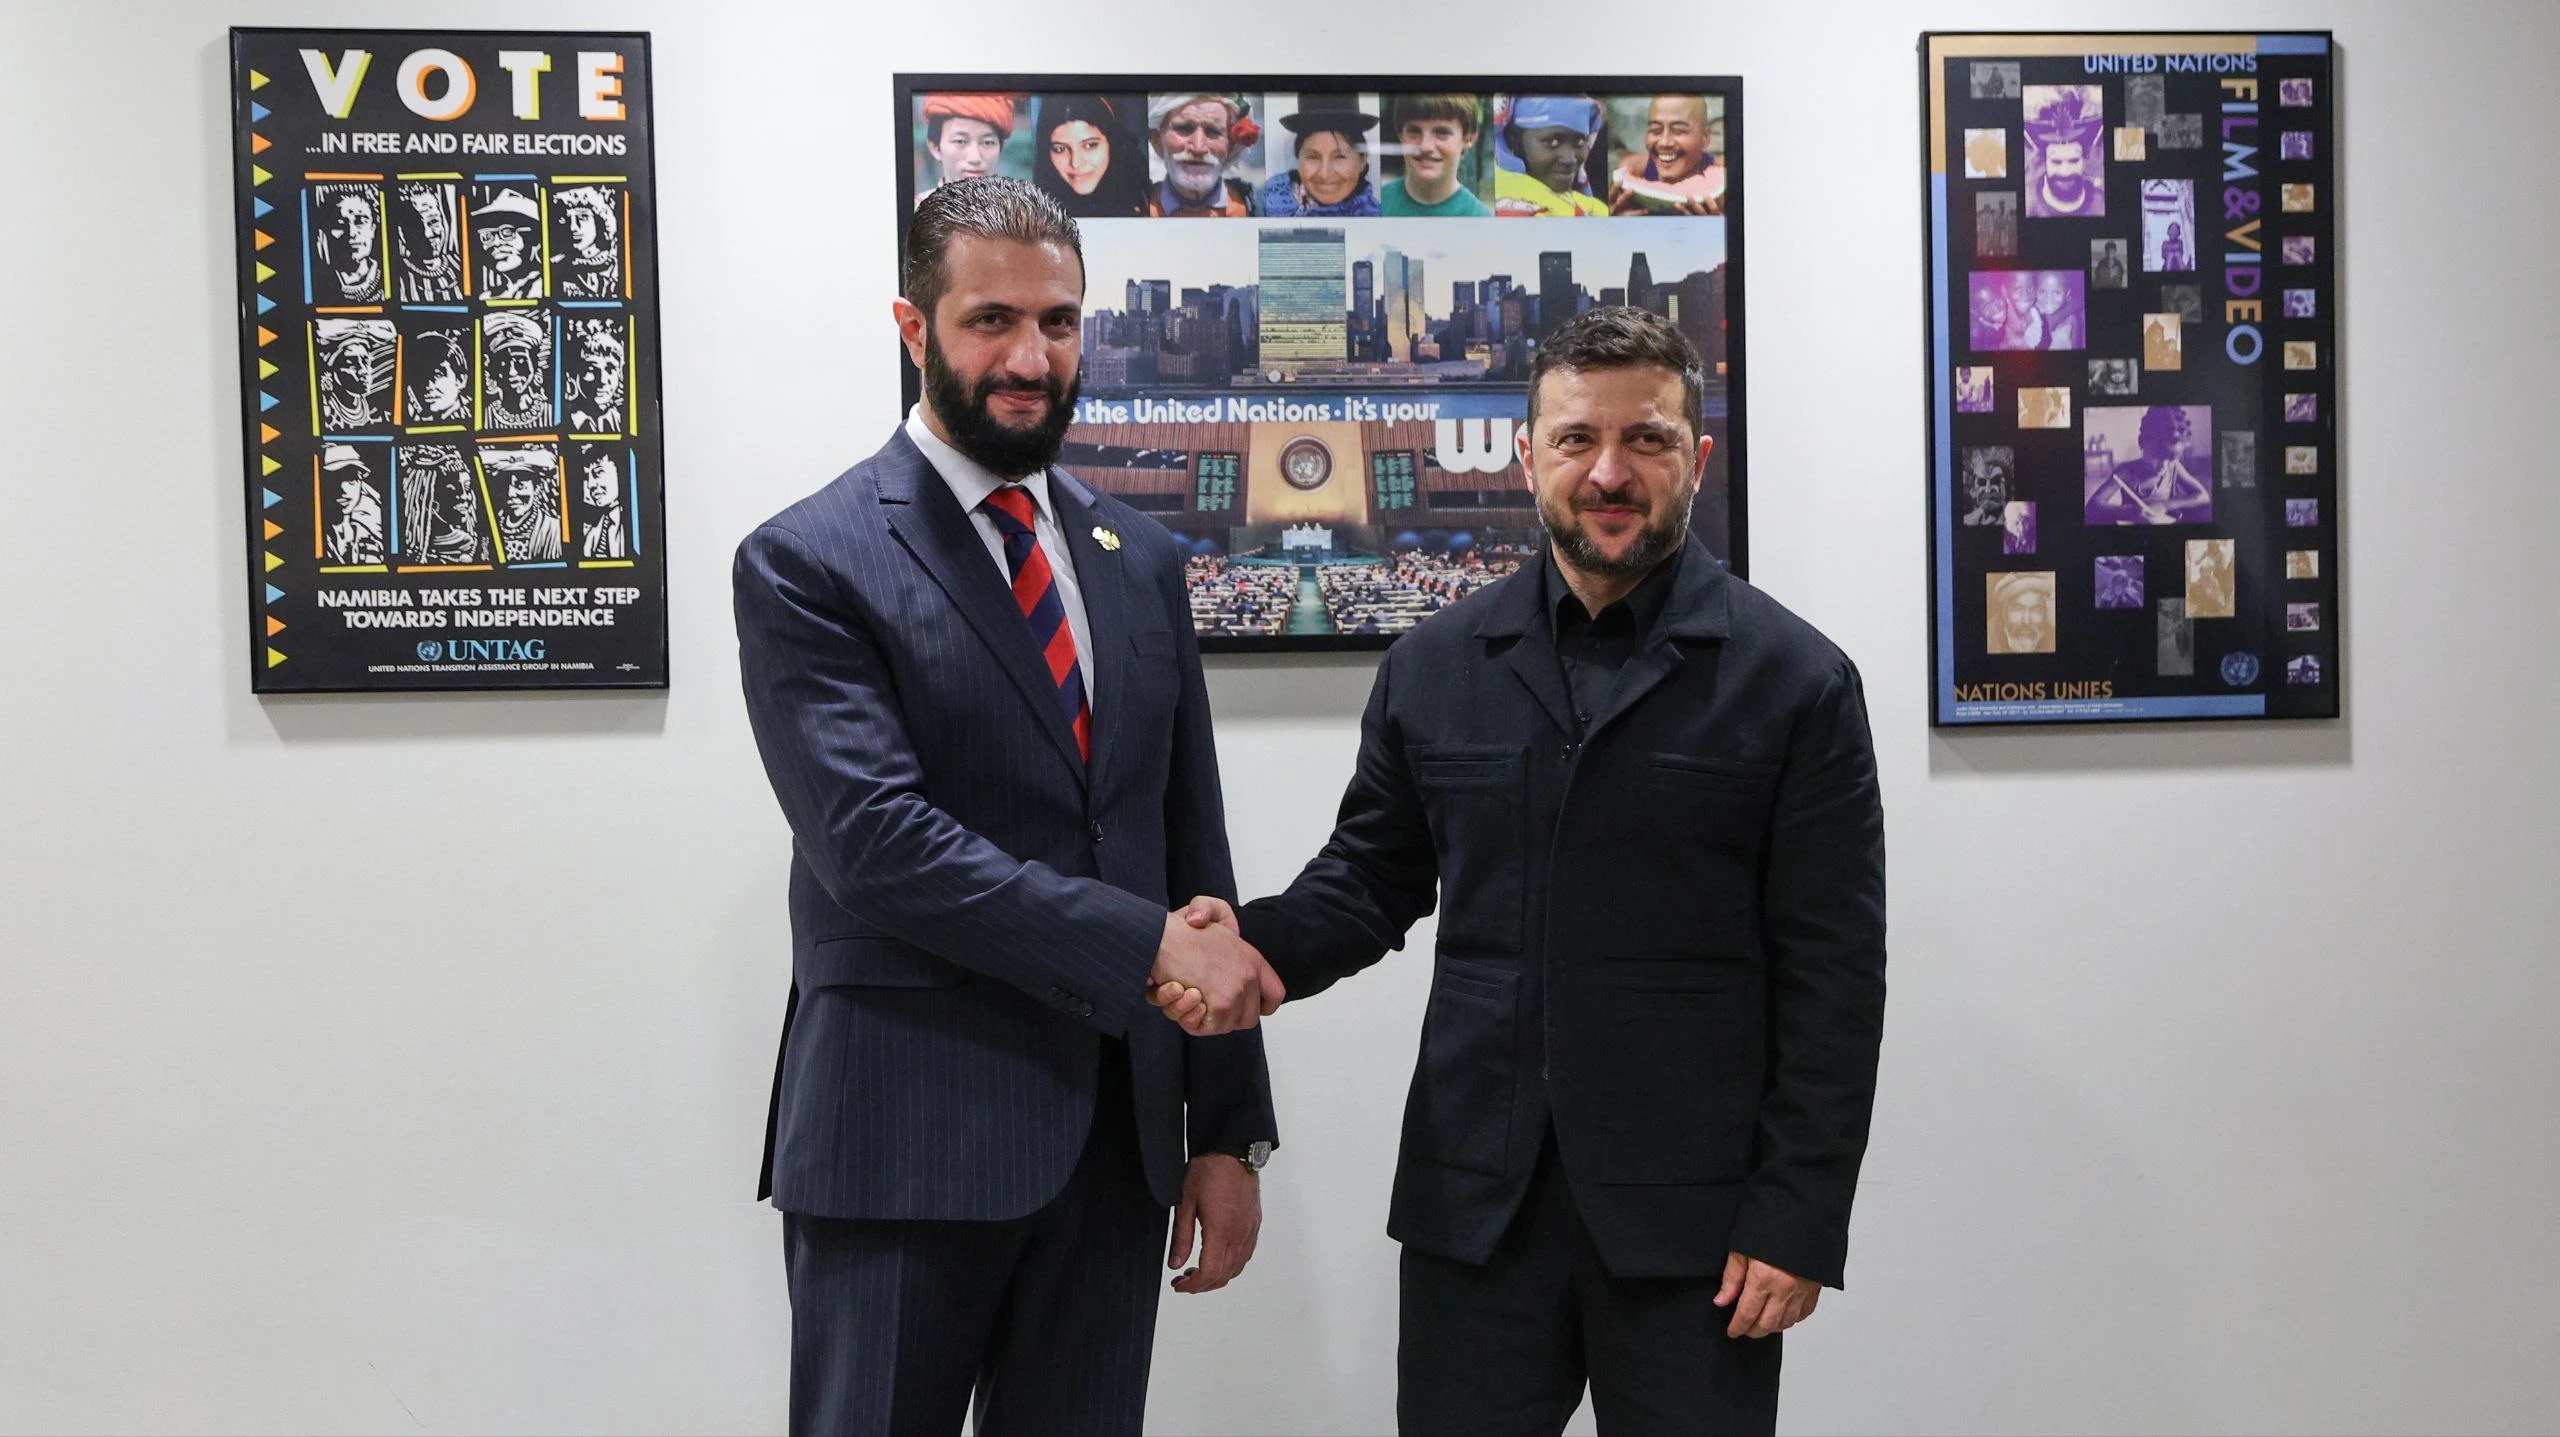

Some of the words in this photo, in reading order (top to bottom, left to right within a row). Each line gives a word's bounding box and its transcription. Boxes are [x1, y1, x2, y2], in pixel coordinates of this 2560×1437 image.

[2083, 54, 2157, 74] UNITED
[2165, 53, 2258, 73] NATIONS
[299, 48, 627, 122] VOTE
[352, 132, 402, 154] FREE
[404, 132, 458, 154] AND
[462, 132, 510, 155] FAIR
[513, 133, 627, 156] ELECTIONS
[1085, 398, 1130, 424] the
[1133, 398, 1222, 424] United
[1228, 397, 1331, 423] Nations
[1345, 396, 1377, 422] it's
[1383, 402, 1440, 427] your
[317, 589, 415, 608] NAMIBIA
[418, 588, 483, 607] TAKES
[487, 588, 527, 606] THE
[532, 587, 589, 606] NEXT
[593, 586, 641, 606] STEP
[342, 610, 448, 629] TOWARDS
[454, 608, 615, 628] INDEPENDENCE
[447, 638, 546, 661] UNTAG
[368, 665, 396, 673] UNITED
[397, 664, 431, 673] NATIONS
[431, 664, 477, 673] TRANSITION
[477, 663, 521, 672] ASSISTANCE
[521, 663, 550, 672] GROUP
[550, 662, 560, 671] IN
[560, 662, 595, 671] NAMIBIA
[1953, 683, 2047, 702] NATIONS
[2054, 680, 2113, 699] UNIES
